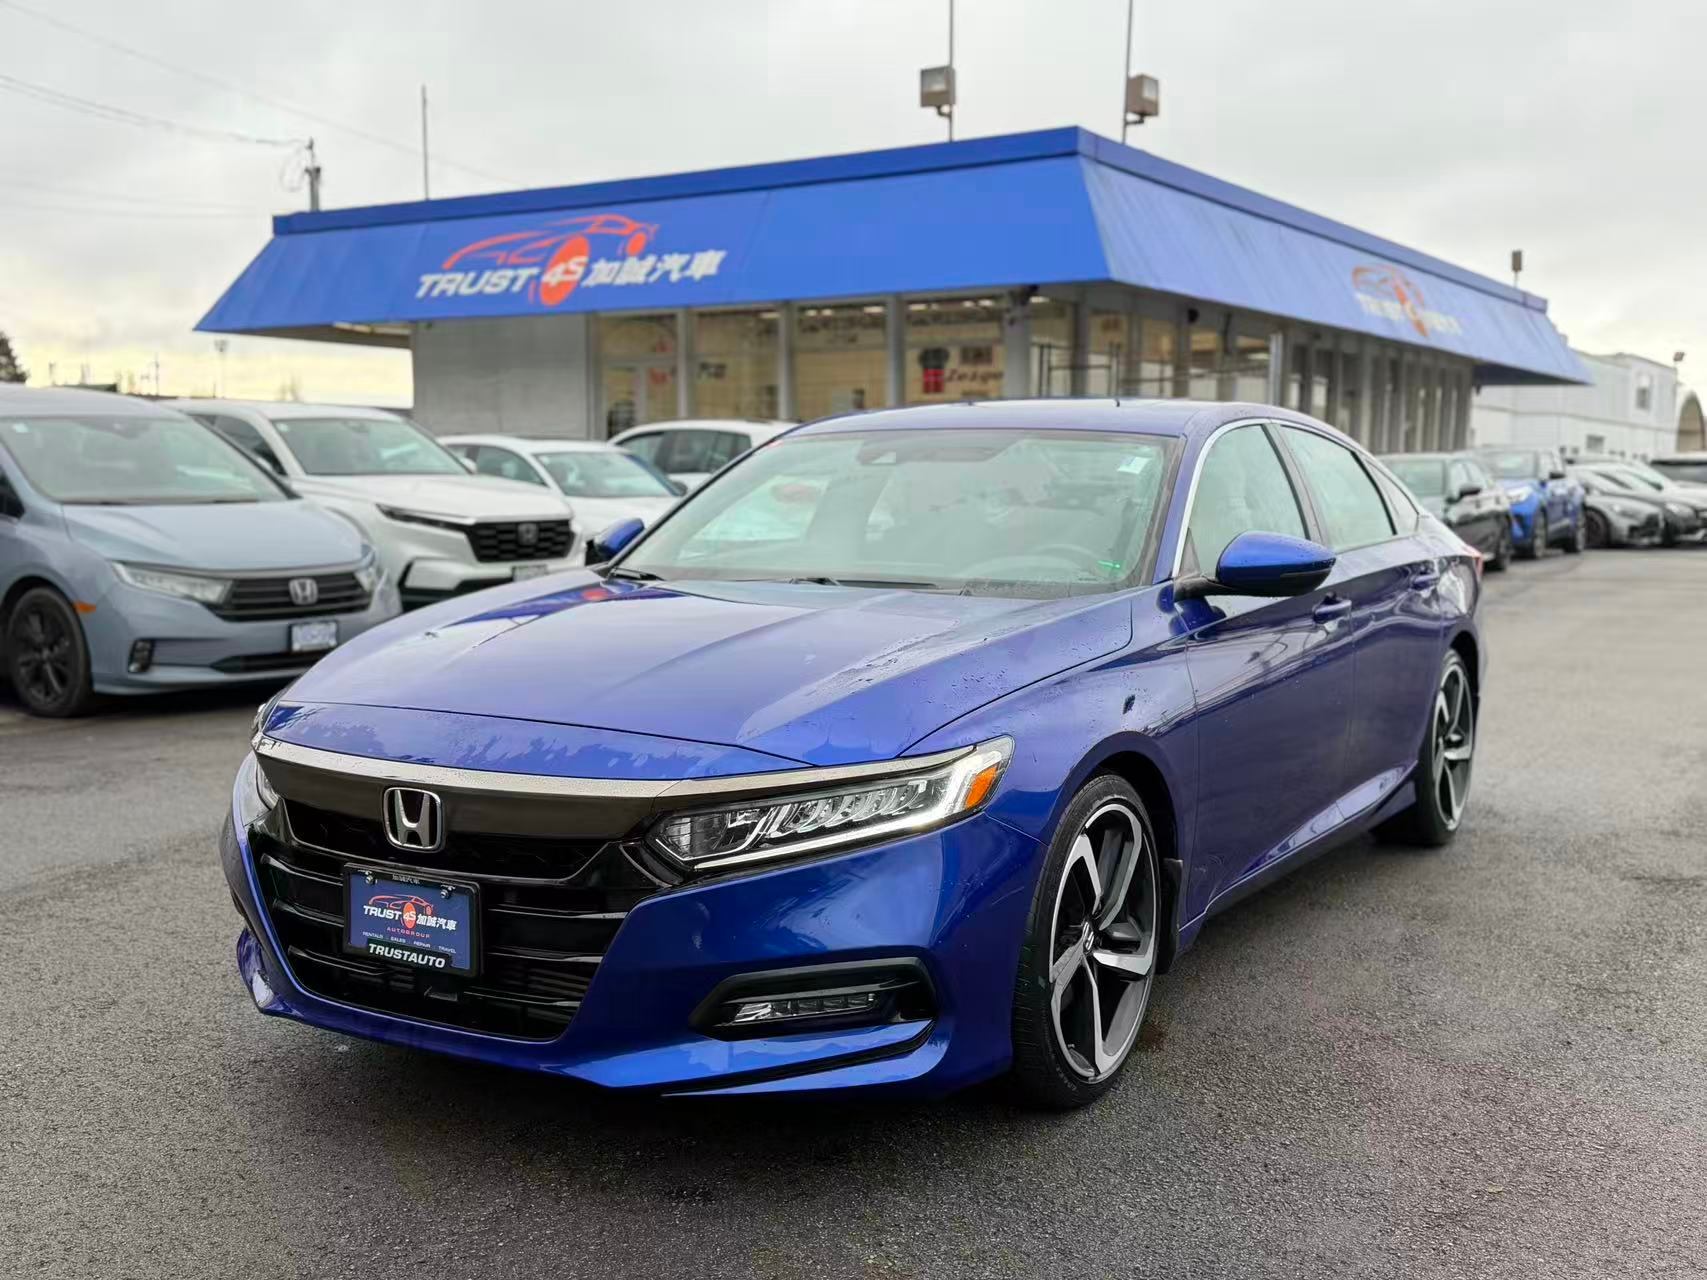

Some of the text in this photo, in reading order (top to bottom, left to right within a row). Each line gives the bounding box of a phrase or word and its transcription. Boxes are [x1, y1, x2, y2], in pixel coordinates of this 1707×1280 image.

[416, 267, 540, 298] TRUST
[542, 256, 588, 286] 4S
[363, 905, 402, 921] TRUST
[403, 911, 417, 922] 4S
[387, 927, 430, 938] AUTOGROUP
[369, 943, 446, 969] TRUSTAUTO
